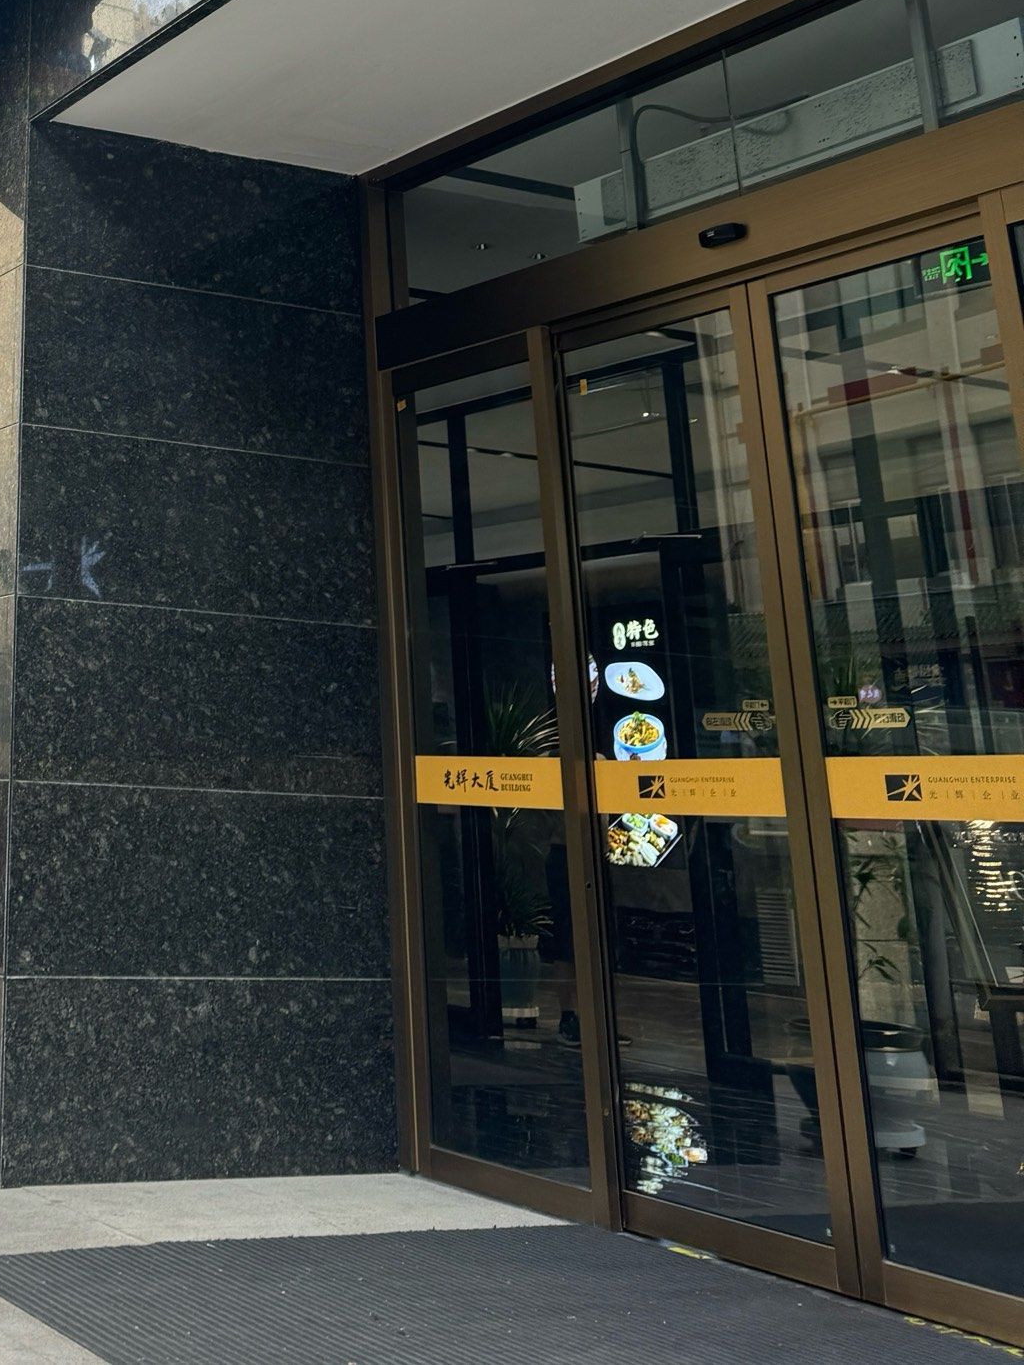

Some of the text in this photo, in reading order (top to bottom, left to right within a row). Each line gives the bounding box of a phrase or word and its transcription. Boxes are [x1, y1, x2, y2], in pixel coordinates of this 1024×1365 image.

[626, 618, 659, 640] 特色
[443, 769, 499, 793] 光辉大厦
[500, 772, 533, 782] GUANGHUI
[669, 776, 735, 784] GUANGHUI ENTERPRISE
[928, 775, 1017, 784] GUANGHUI ENTERPRISE
[500, 784, 531, 792] BUILDING
